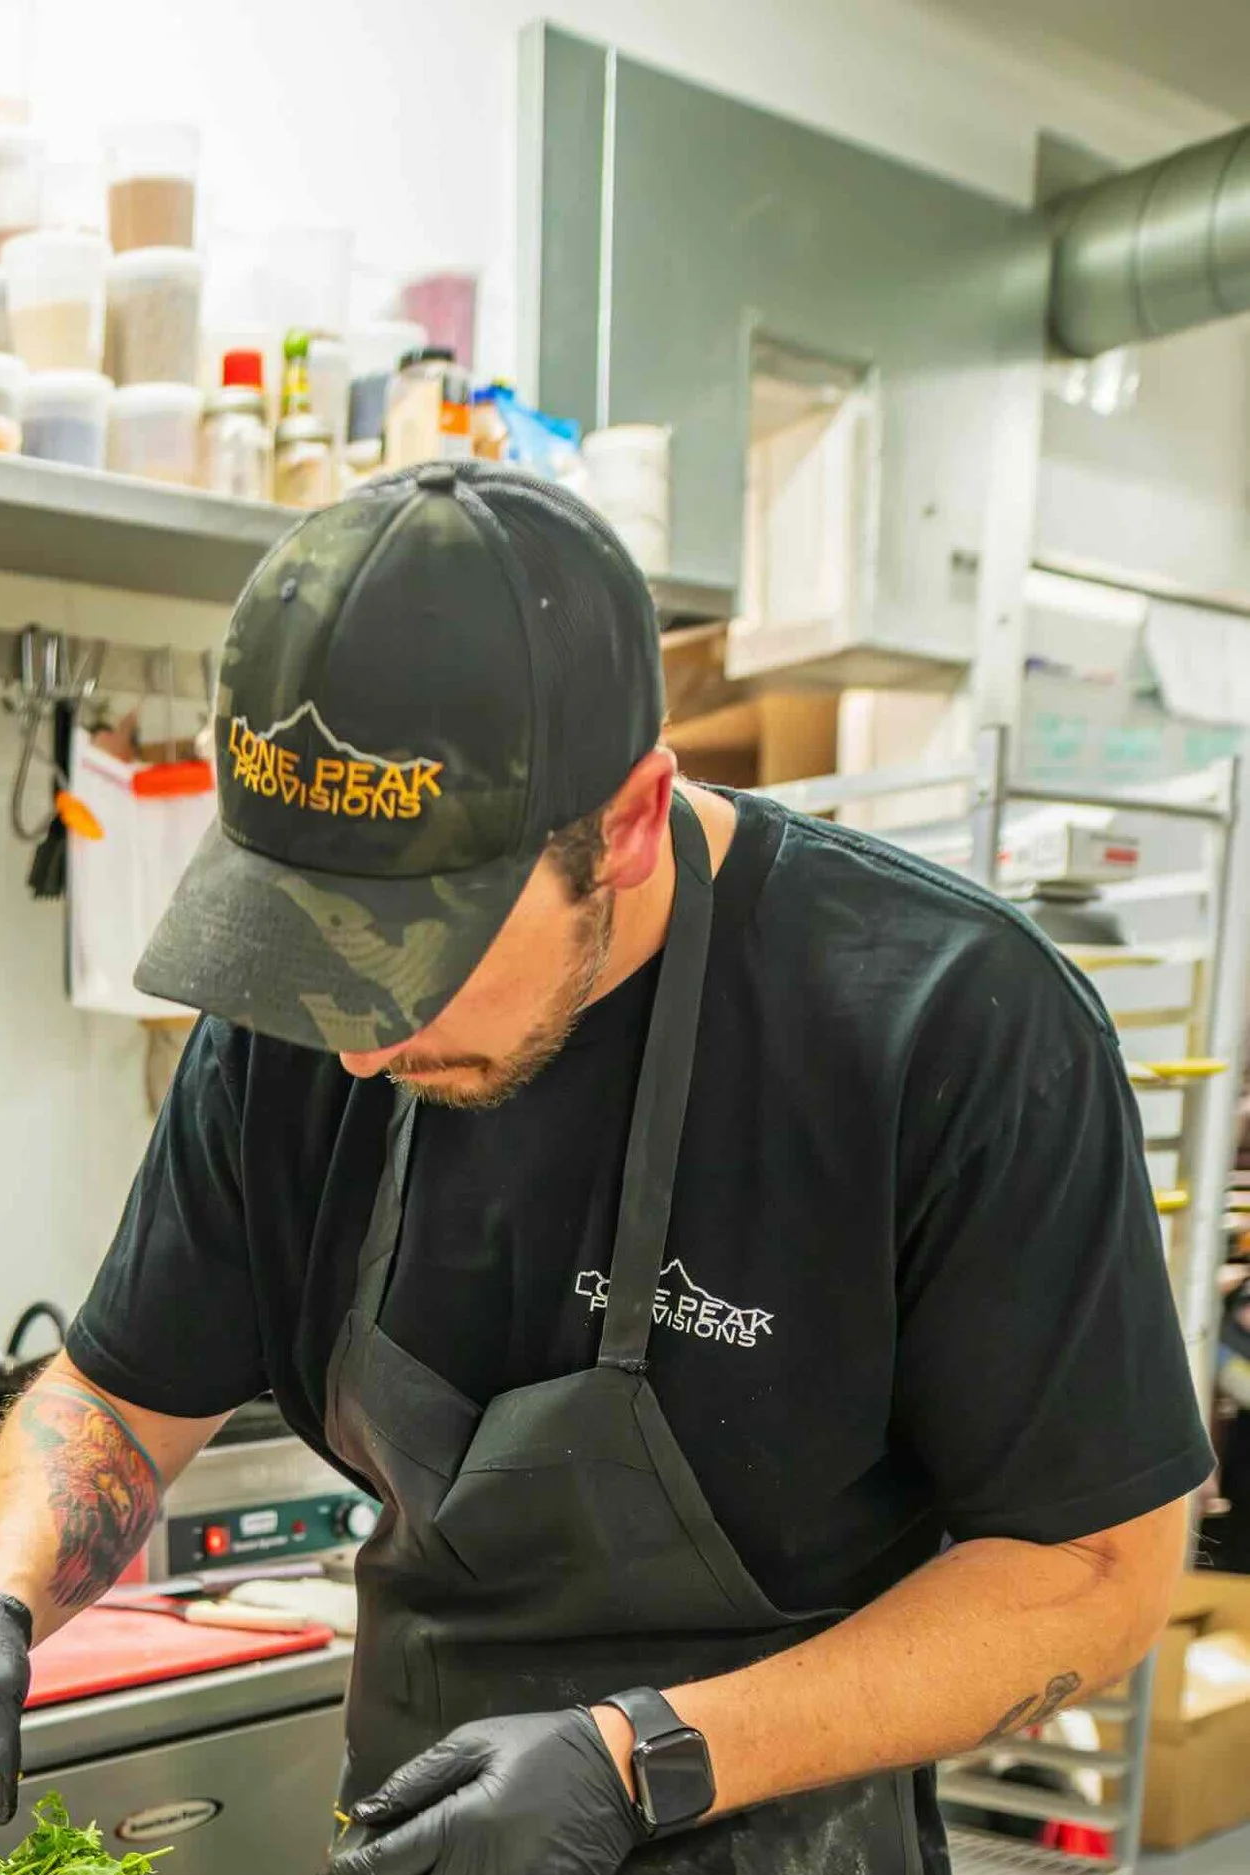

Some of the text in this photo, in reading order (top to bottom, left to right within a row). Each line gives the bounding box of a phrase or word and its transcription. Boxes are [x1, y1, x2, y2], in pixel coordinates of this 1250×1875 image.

[228, 717, 444, 799] LONE PEAK
[233, 756, 422, 821] PROVISIONS
[574, 1271, 775, 1335] LOE PEAK
[589, 1294, 757, 1349] PVISIONS
